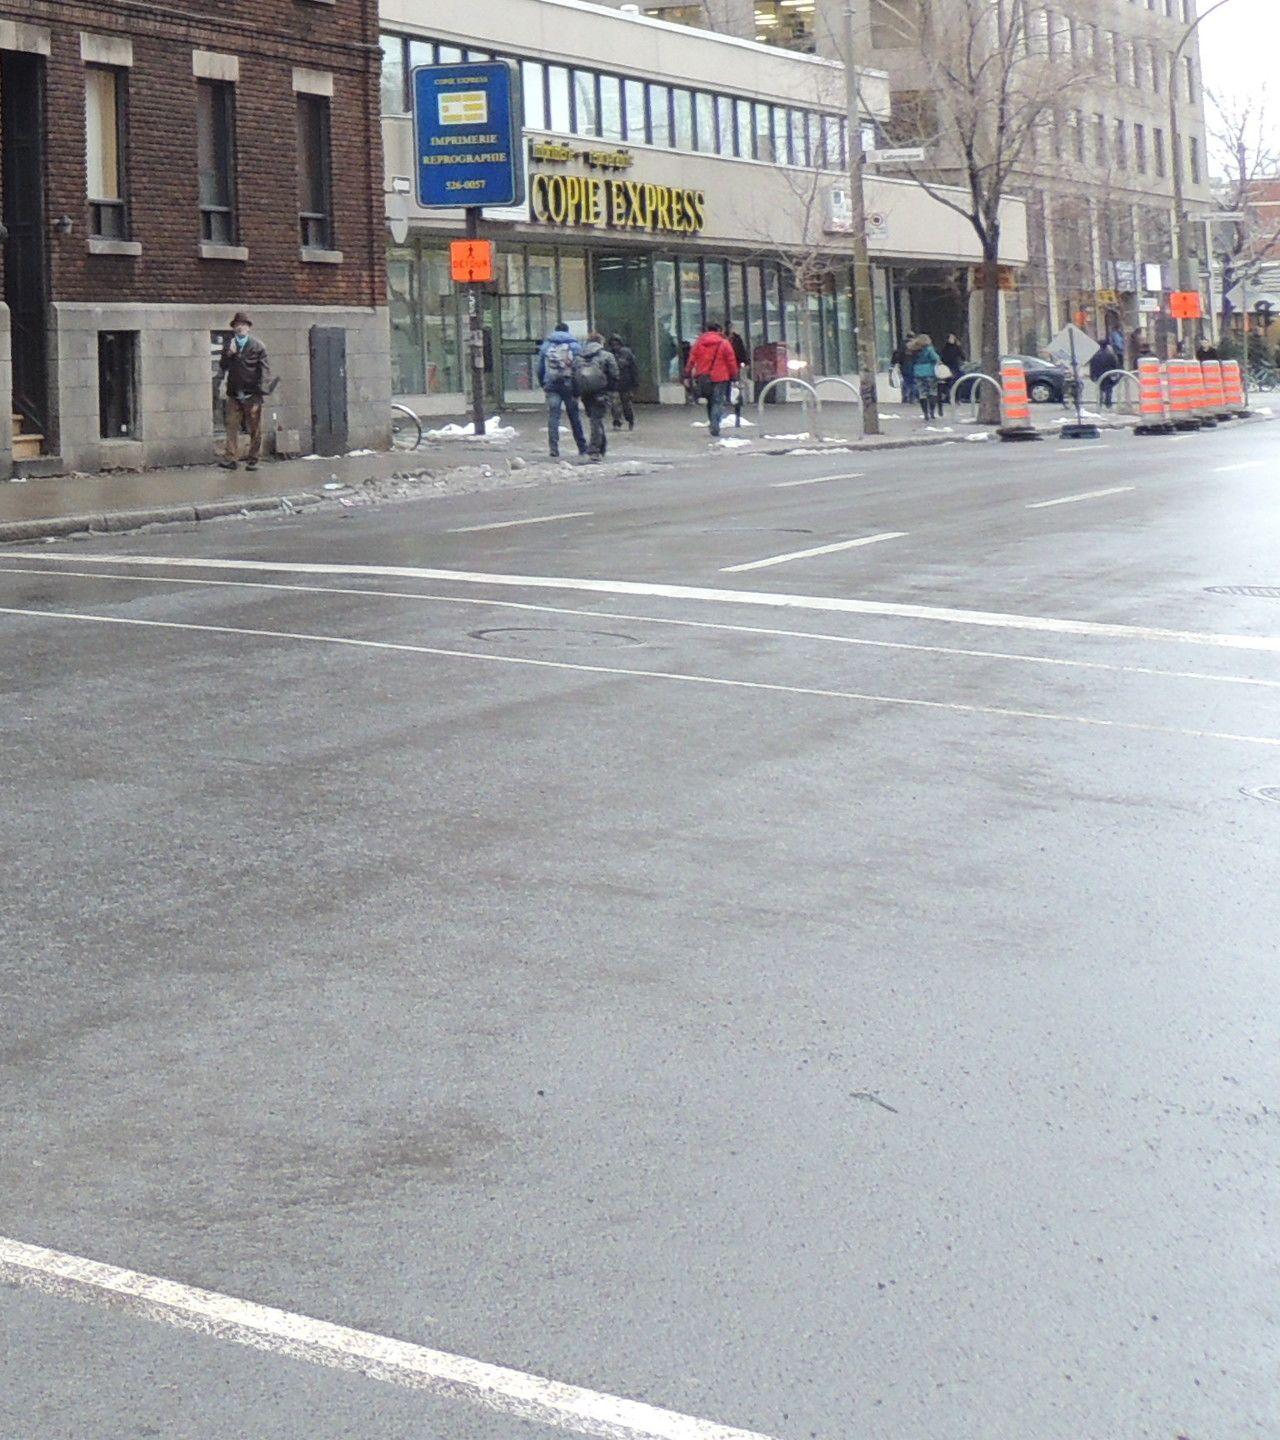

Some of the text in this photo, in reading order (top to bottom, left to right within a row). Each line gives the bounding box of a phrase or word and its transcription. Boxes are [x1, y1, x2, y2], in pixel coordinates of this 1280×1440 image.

[430, 134, 498, 146] IMPRIMERIE
[422, 152, 508, 165] REPROGRAPHIE
[532, 174, 706, 233] COPIE EXPRESS
